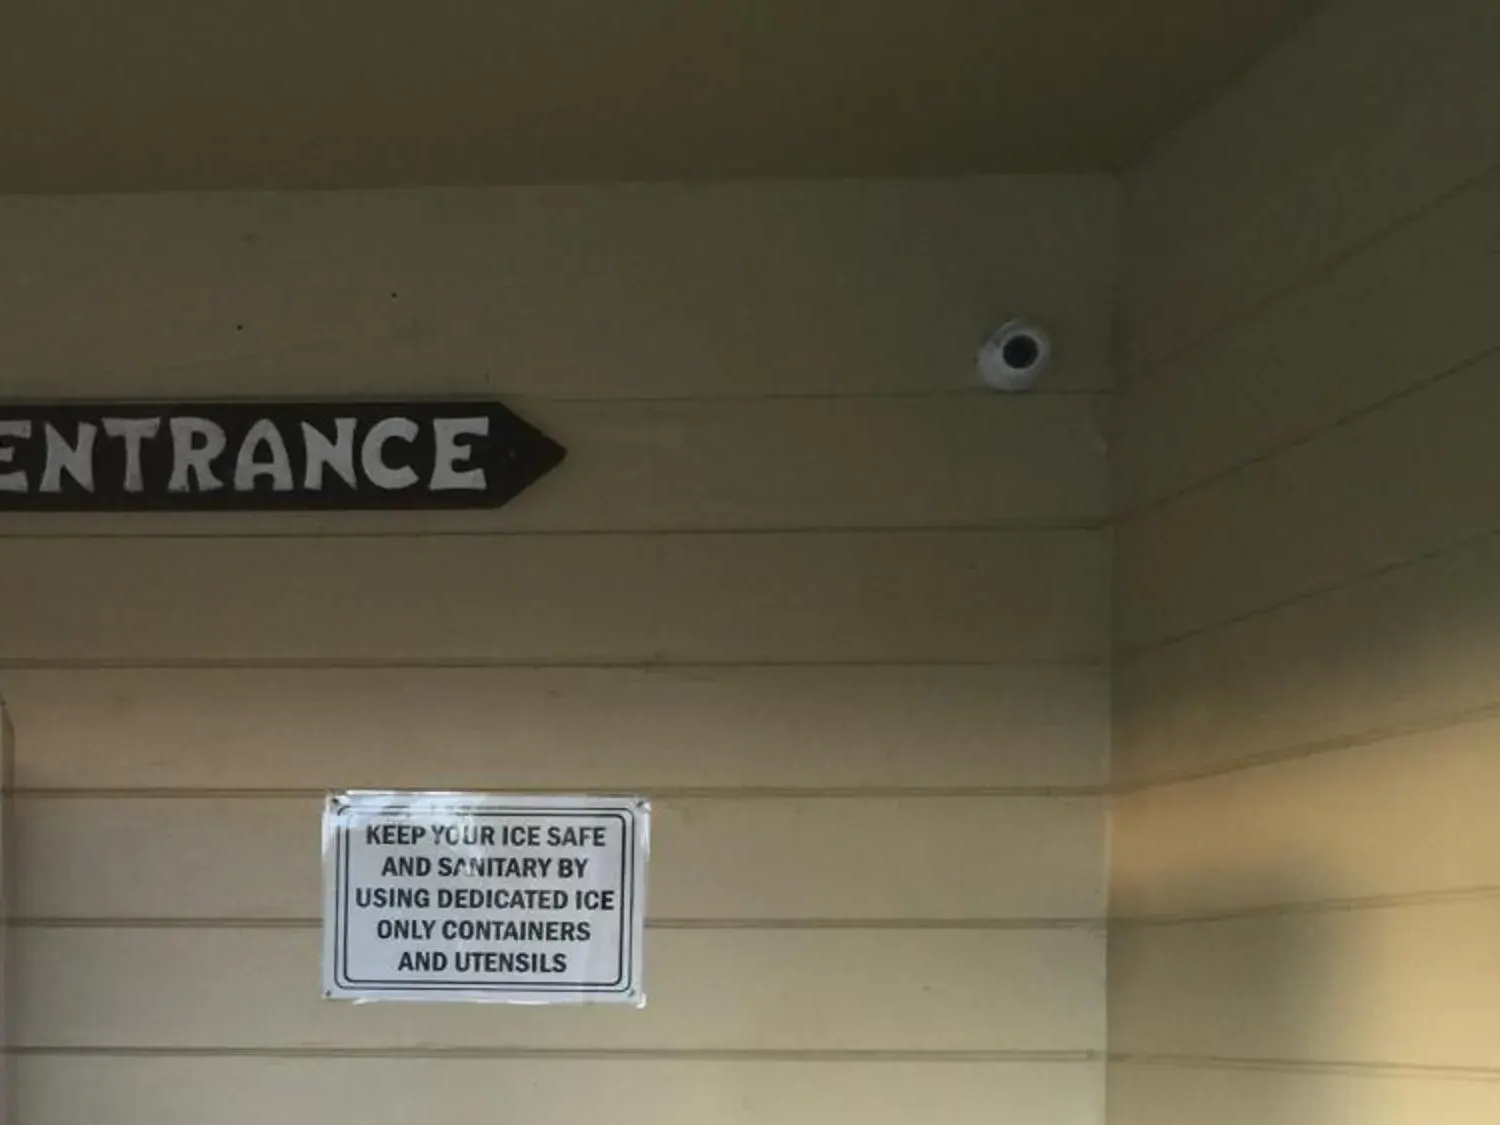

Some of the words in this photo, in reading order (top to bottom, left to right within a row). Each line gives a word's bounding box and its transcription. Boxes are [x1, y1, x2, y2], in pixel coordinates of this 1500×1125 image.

[365, 824, 426, 846] KEEP
[431, 824, 496, 846] YOUR
[501, 825, 542, 848] ICE
[546, 826, 607, 848] SAFE
[381, 855, 432, 877] AND
[437, 856, 552, 878] SANITARY
[557, 857, 589, 879] BY
[355, 887, 430, 909] USING
[437, 888, 569, 910] DEDICATED
[575, 889, 615, 911] ICE
[377, 919, 437, 940] ONLY
[441, 920, 592, 942] CONTAINERS
[397, 951, 448, 972] AND
[454, 951, 568, 974] UTENSILS
